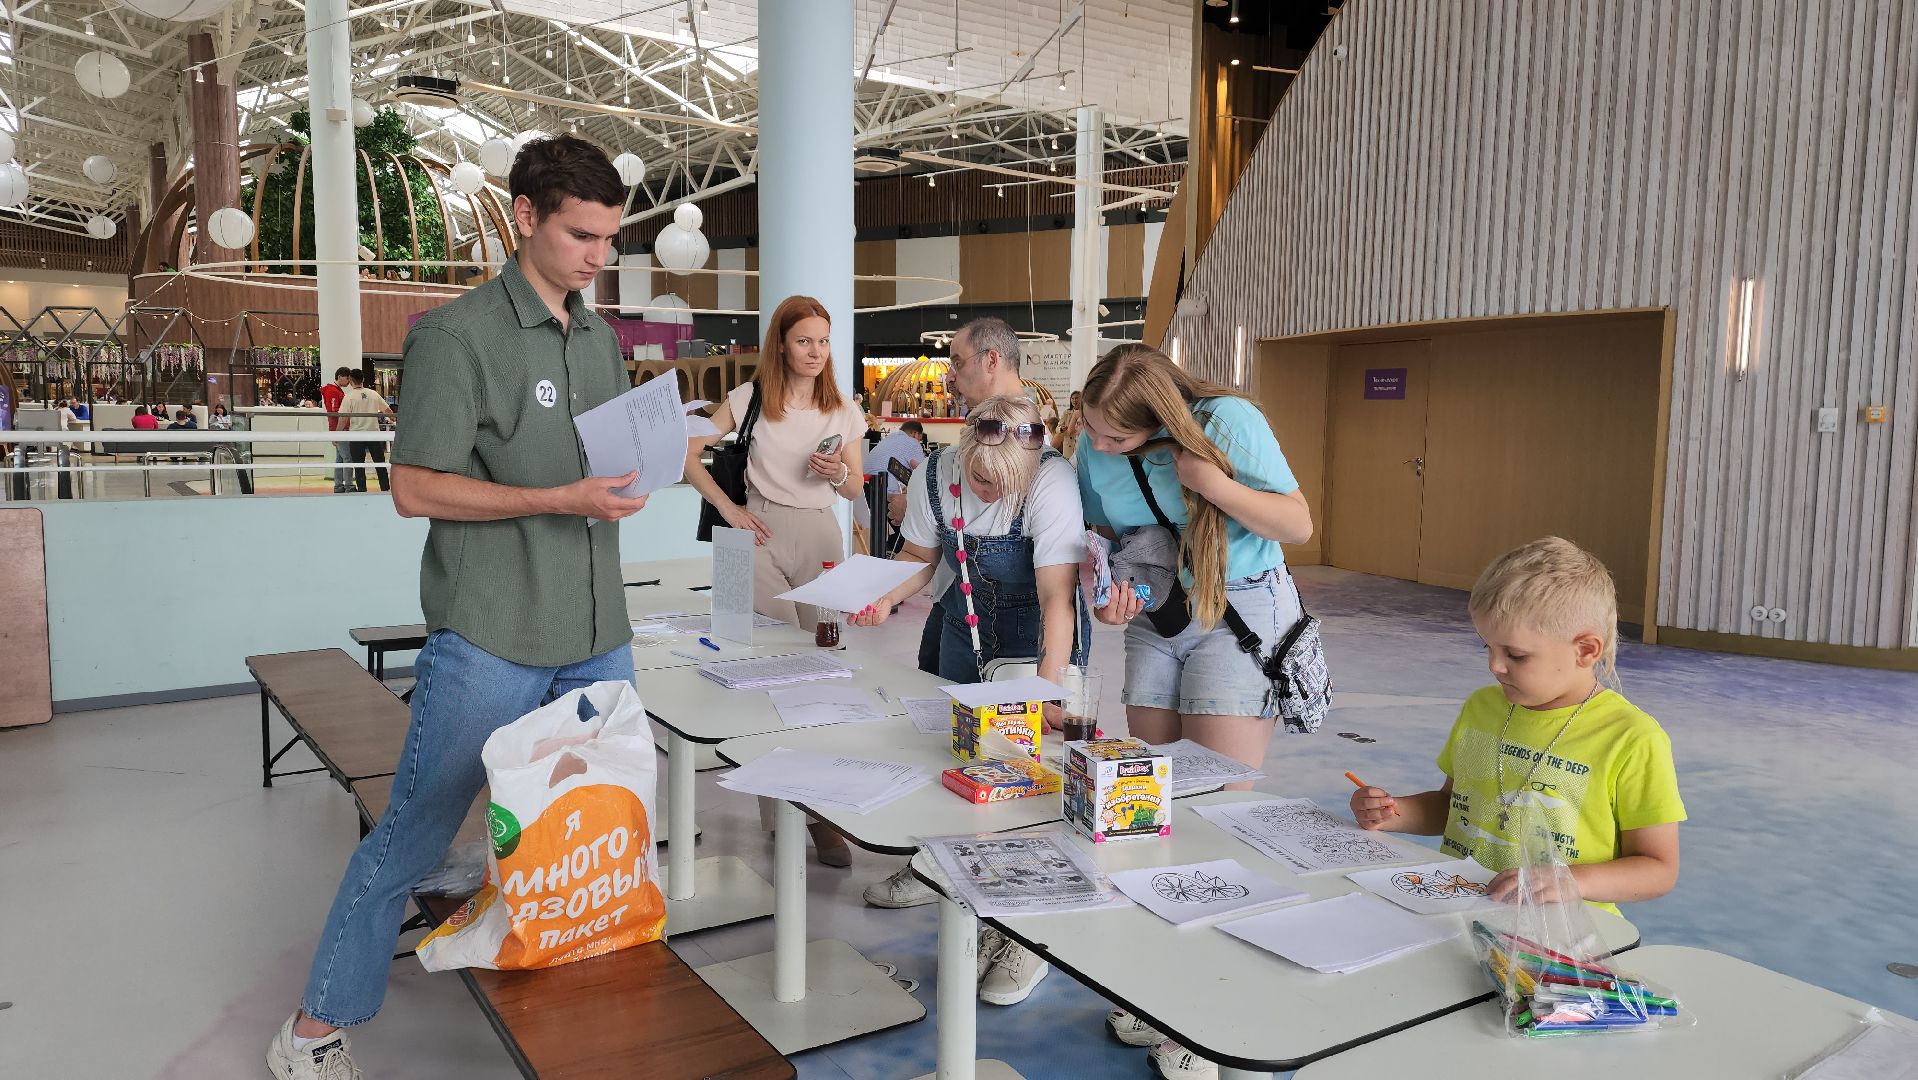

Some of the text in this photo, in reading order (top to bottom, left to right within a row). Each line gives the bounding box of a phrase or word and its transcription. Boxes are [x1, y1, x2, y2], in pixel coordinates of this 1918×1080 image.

[540, 385, 554, 403] 22
[1500, 743, 1532, 760] LEGENDS
[1546, 755, 1564, 770] THE
[1565, 760, 1590, 776] DEEP
[564, 809, 581, 841] Я
[1565, 847, 1580, 859] THE
